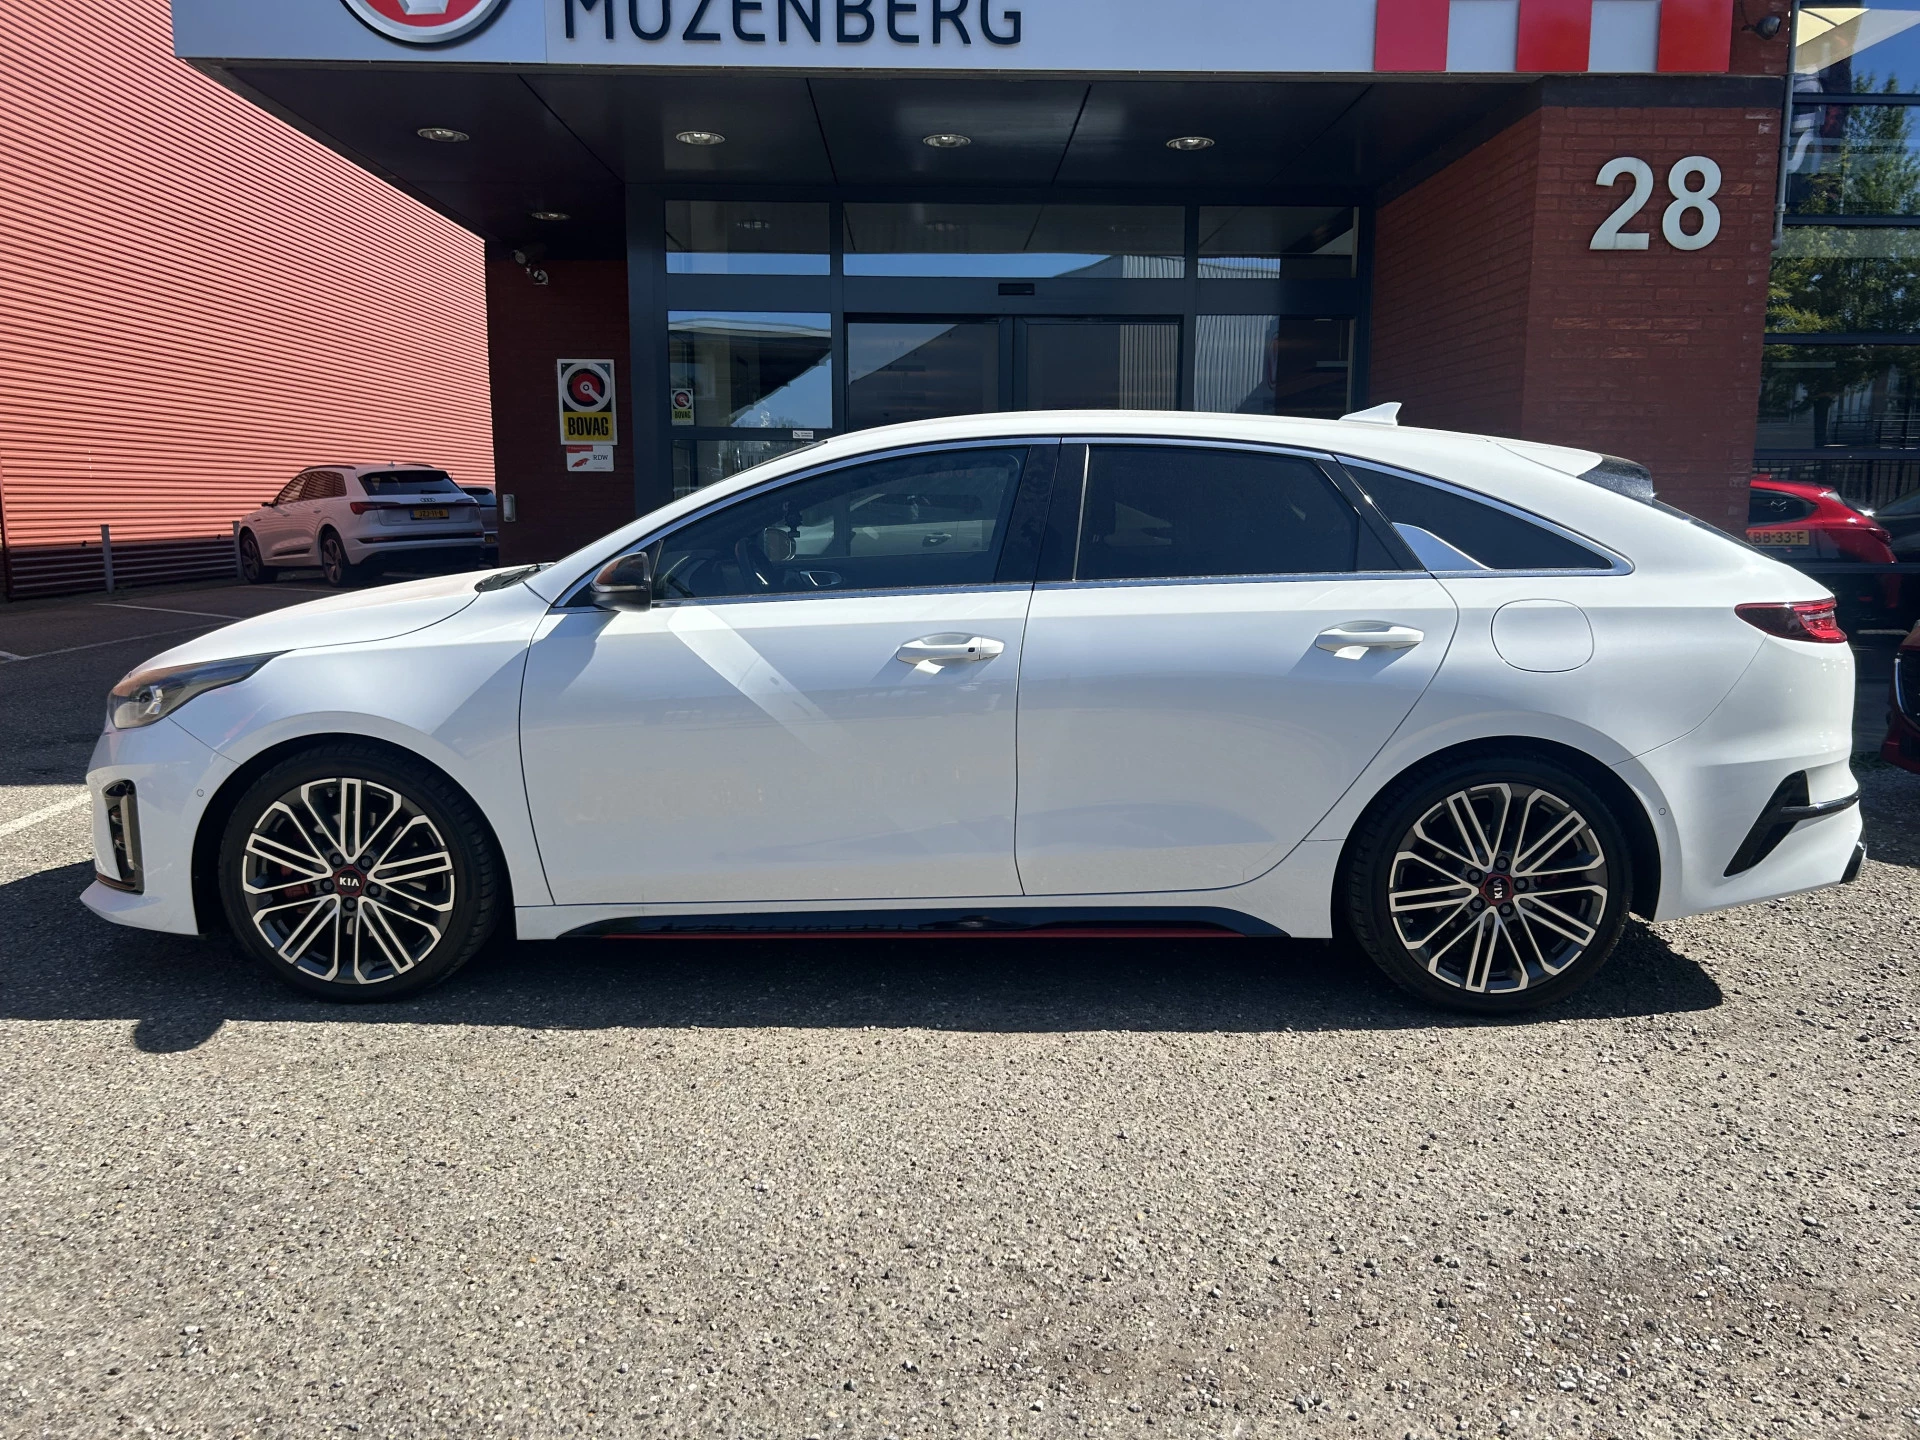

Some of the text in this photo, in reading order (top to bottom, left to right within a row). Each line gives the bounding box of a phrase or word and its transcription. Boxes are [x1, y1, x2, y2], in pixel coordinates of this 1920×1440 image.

[1589, 155, 1722, 251] 28
[674, 410, 691, 419] BOVAG
[567, 416, 609, 436] BOVAG
[339, 876, 359, 887] KIA
[1493, 878, 1503, 899] KIA
